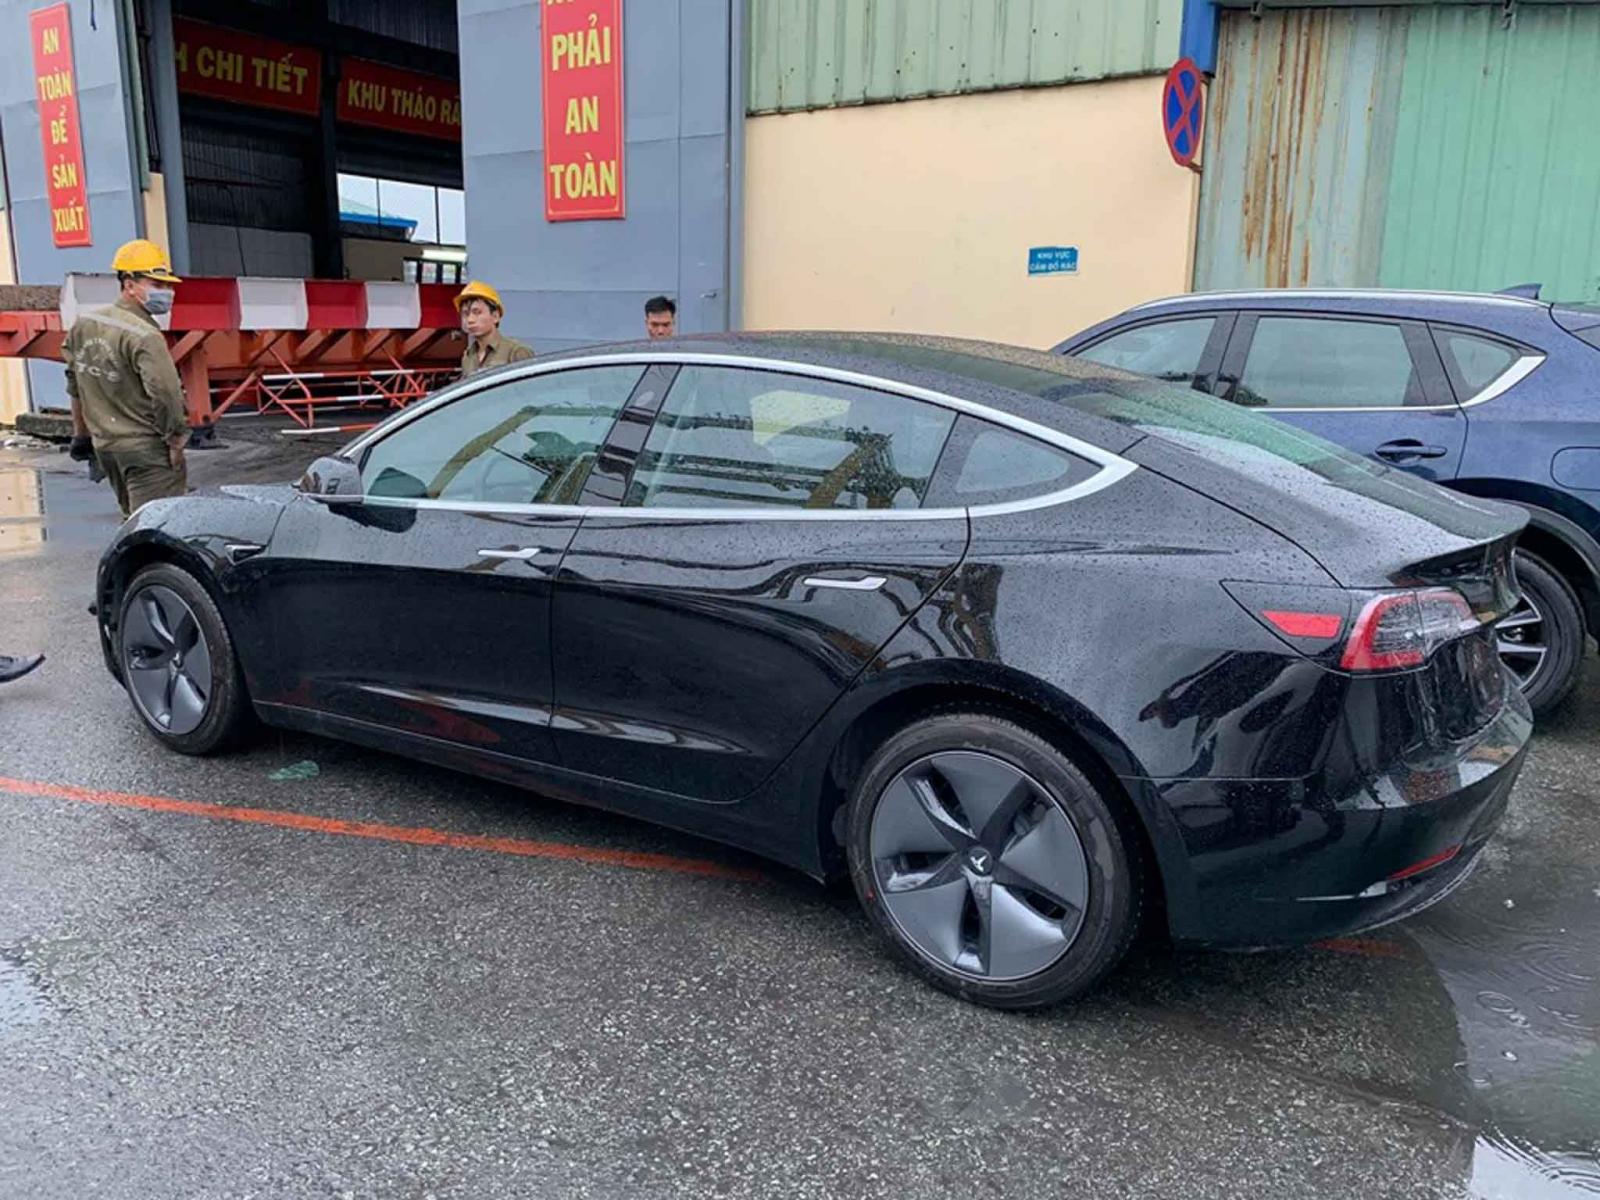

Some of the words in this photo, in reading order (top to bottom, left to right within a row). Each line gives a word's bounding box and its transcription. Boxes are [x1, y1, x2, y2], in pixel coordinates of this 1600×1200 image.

[42, 26, 59, 55] AN
[551, 13, 611, 72] PHẢI
[38, 66, 72, 102] TOÀN
[196, 45, 243, 84] CHI
[251, 52, 308, 95] TIẾT
[348, 79, 386, 112] KHU
[391, 86, 437, 121] THÁO
[565, 95, 599, 136] AN
[51, 104, 69, 145] ĐỂ
[52, 153, 78, 189] SẢN
[550, 152, 617, 200] TOÀN
[53, 197, 85, 233] XUẤT
